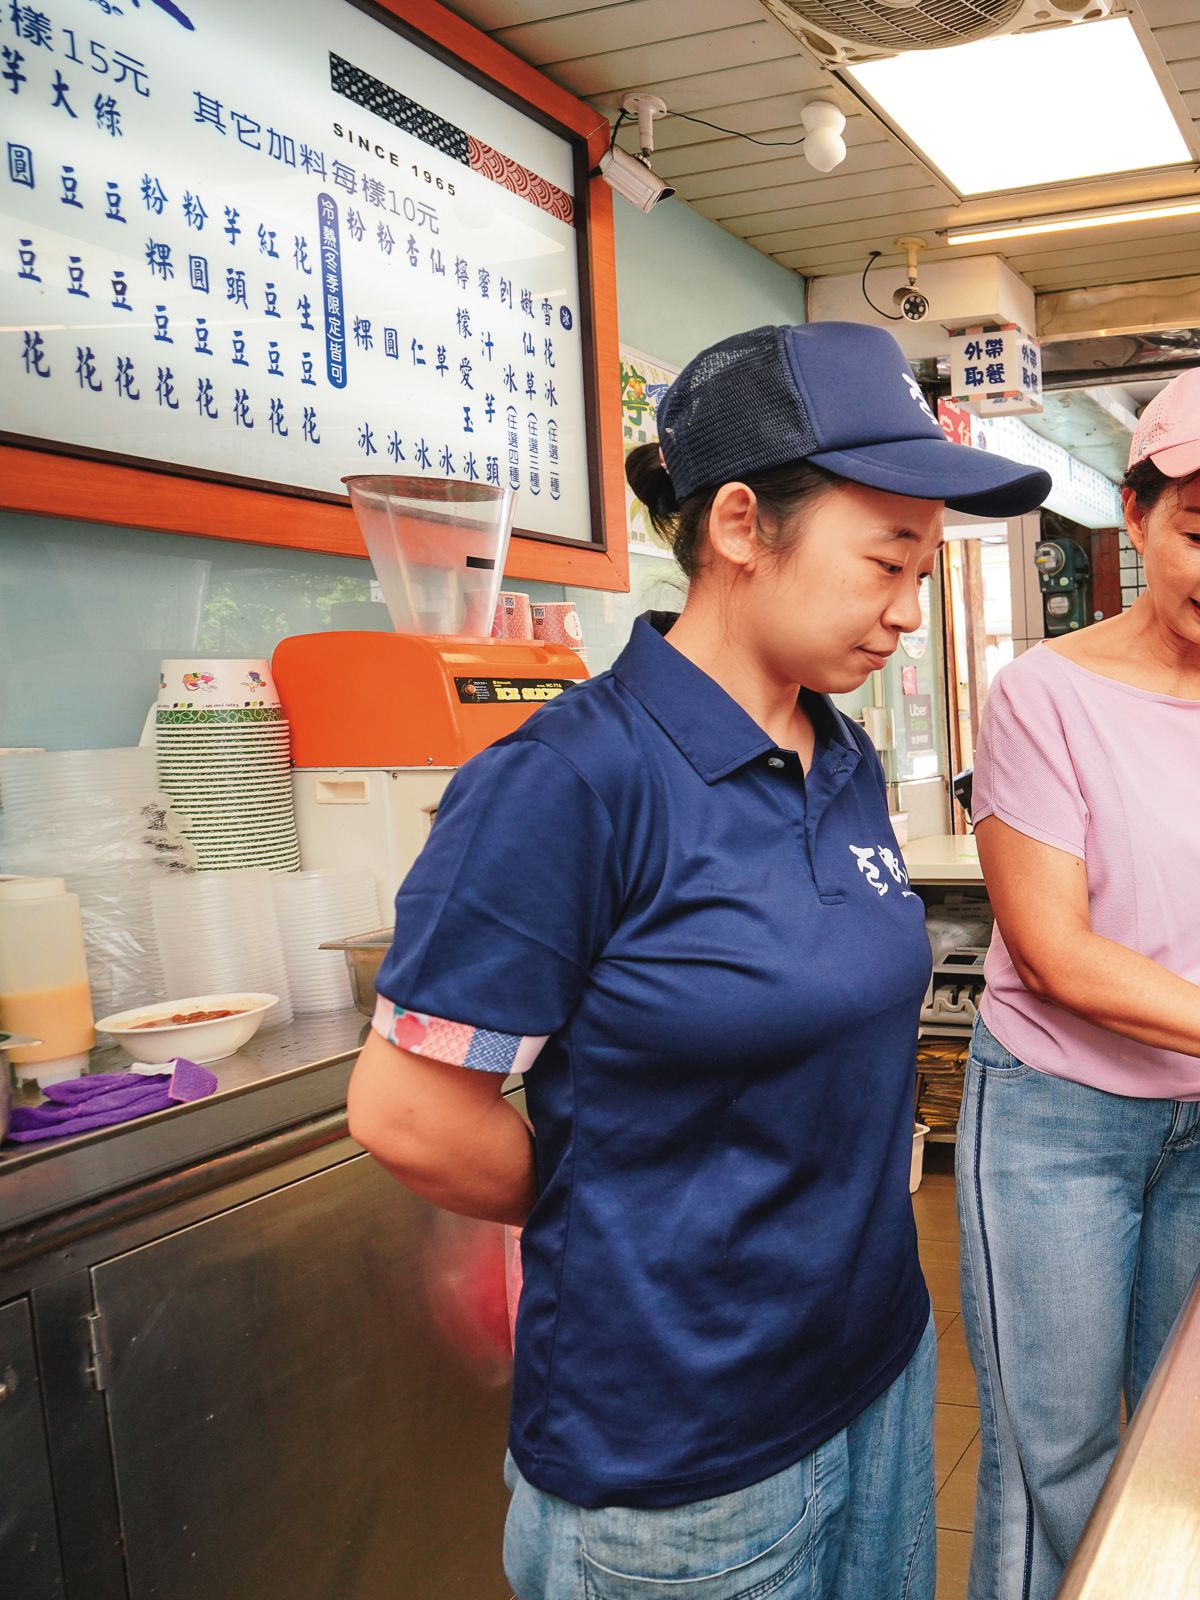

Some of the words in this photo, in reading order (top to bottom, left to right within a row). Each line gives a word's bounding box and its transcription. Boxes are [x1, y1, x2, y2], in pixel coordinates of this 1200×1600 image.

[0, 0, 150, 97] 樣15元
[193, 90, 440, 235] 其它加料每樣10元
[333, 122, 399, 167] SINCE
[411, 164, 457, 196] 1965
[964, 338, 1004, 361] 外帶
[964, 363, 1005, 387] 取餐
[495, 688, 521, 700] ICE
[909, 704, 927, 717] Uber
